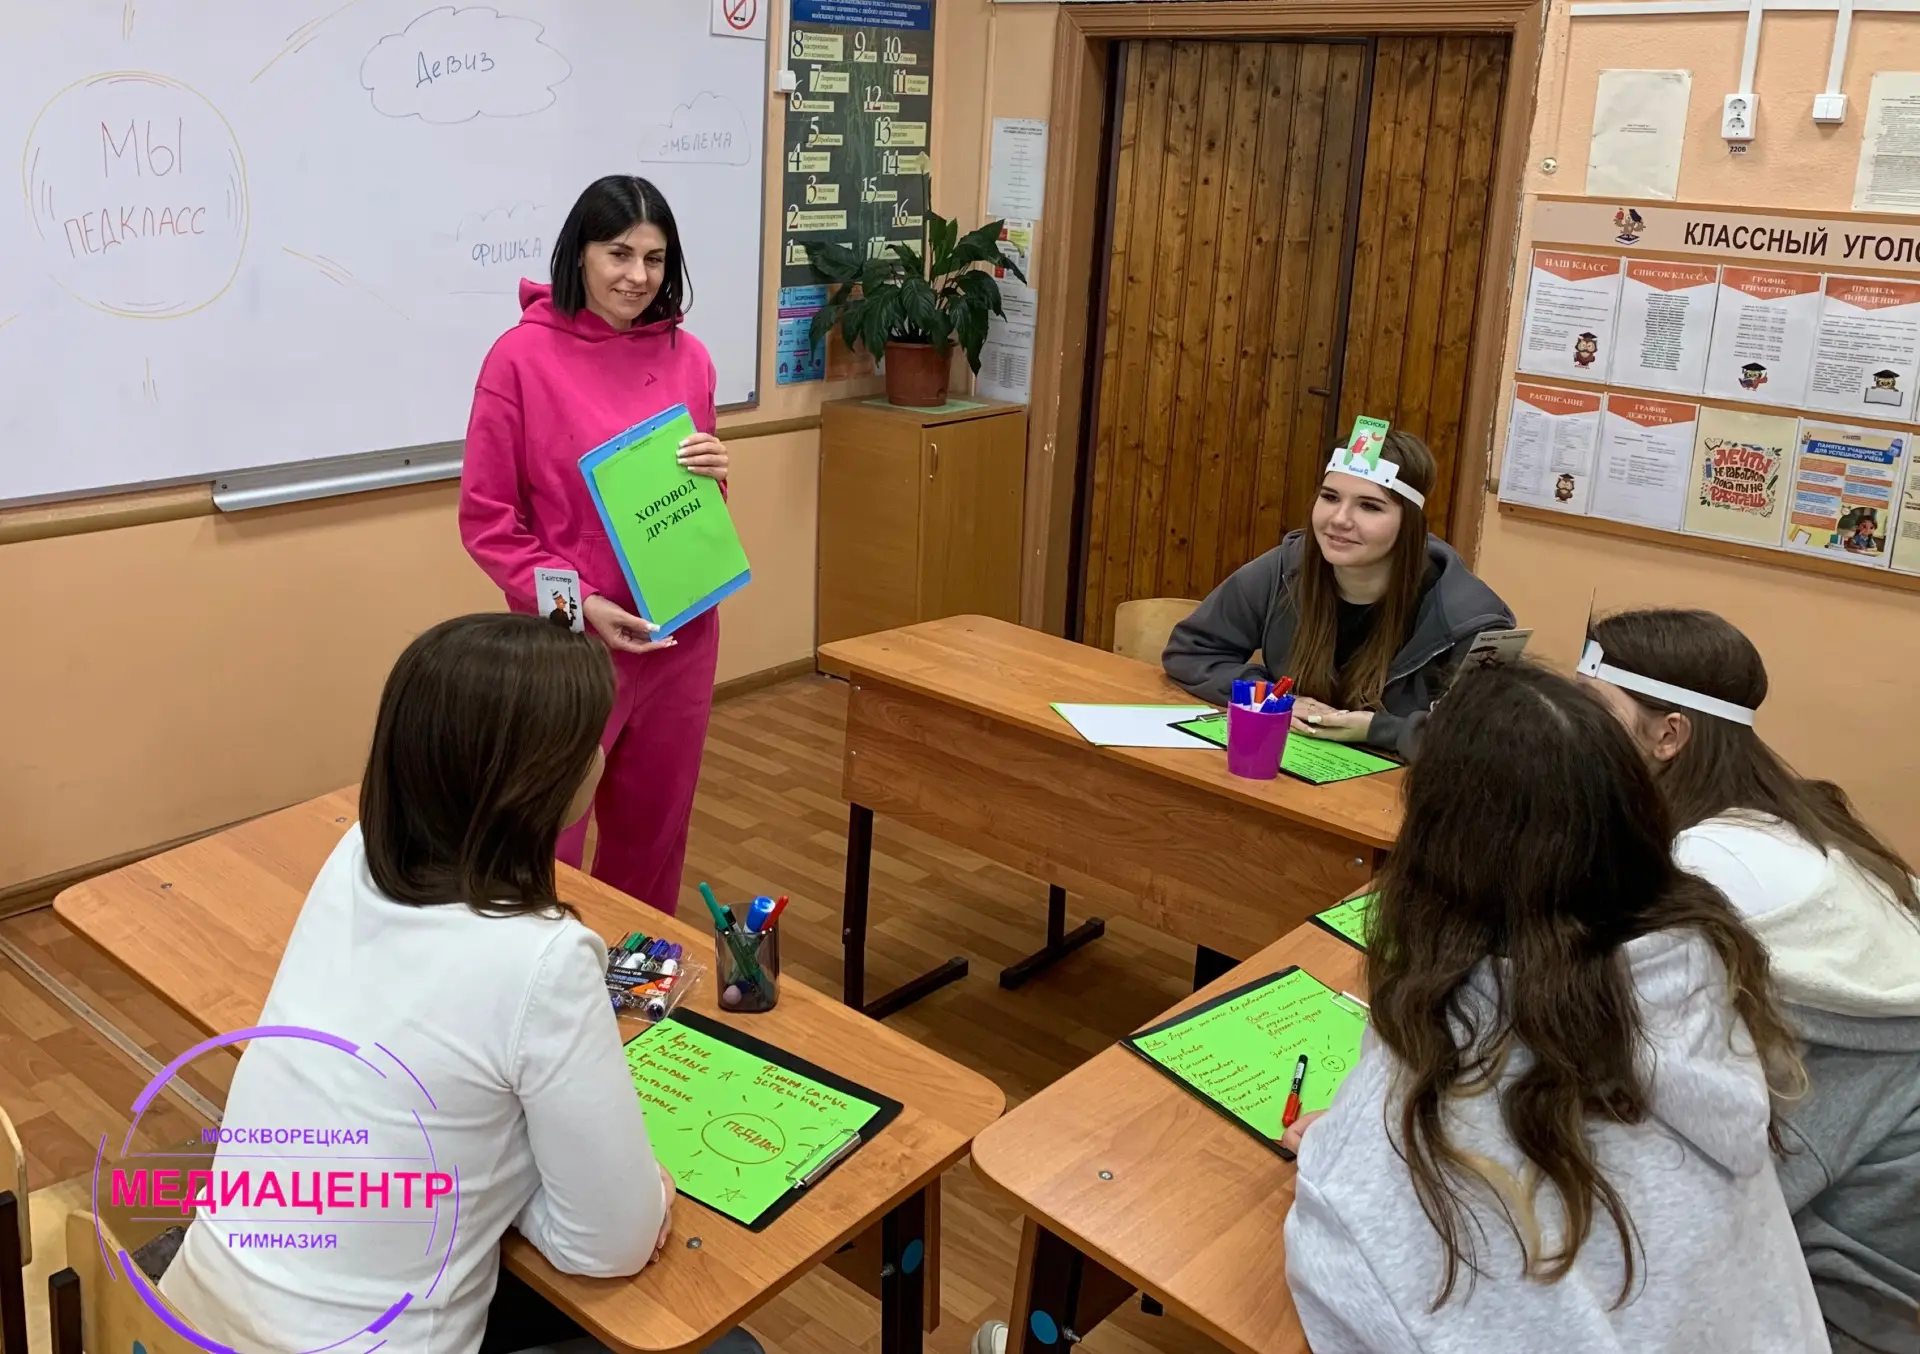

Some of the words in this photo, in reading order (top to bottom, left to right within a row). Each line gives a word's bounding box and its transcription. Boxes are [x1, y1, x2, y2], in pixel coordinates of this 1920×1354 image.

[792, 30, 804, 57] 8
[854, 31, 866, 60] 9
[884, 36, 902, 62] 10
[810, 64, 822, 91] 7
[894, 69, 907, 94] 11
[790, 80, 803, 110] 6
[864, 86, 881, 110] 12
[806, 116, 820, 148] 5
[875, 116, 892, 144] 13
[101, 117, 182, 177] МЫ
[789, 143, 802, 171] 4
[883, 149, 899, 176] 14
[807, 175, 817, 204] 3
[861, 177, 878, 204] 15
[788, 204, 800, 229] 2
[892, 198, 909, 226] 16
[64, 206, 206, 258] ПЕДКЛАСС
[1684, 222, 1828, 257] КЛАССНЫЙ
[472, 236, 543, 267] ФИШКА
[787, 239, 794, 263] 1
[868, 236, 886, 260] 17
[1545, 258, 1570, 269] НАШ
[1572, 262, 1609, 273] КЛАСС
[1633, 268, 1671, 280] СПИСОК
[1671, 272, 1709, 283] КЛАССА
[1740, 284, 1797, 296] ТРИМЕСТРОВ
[1752, 275, 1788, 285] ГРАФИК
[1851, 285, 1895, 296] ПРАВИЛА
[1843, 294, 1901, 306] ПОВЕДЕНИЯ
[1529, 392, 1585, 407] РАСПИСАНИЕ
[1634, 403, 1668, 414] ГРАФИК
[1358, 418, 1386, 429] СОСИСКА
[1626, 411, 1673, 424] ДЕЖУРСТВА
[1817, 442, 1846, 452] ПАМЯТКА
[1714, 448, 1773, 474] МЕЧТЫ
[634, 478, 698, 524] ХОРОВОД
[645, 497, 702, 543] ДРУЖБЫ
[634, 1085, 678, 1115] ивные
